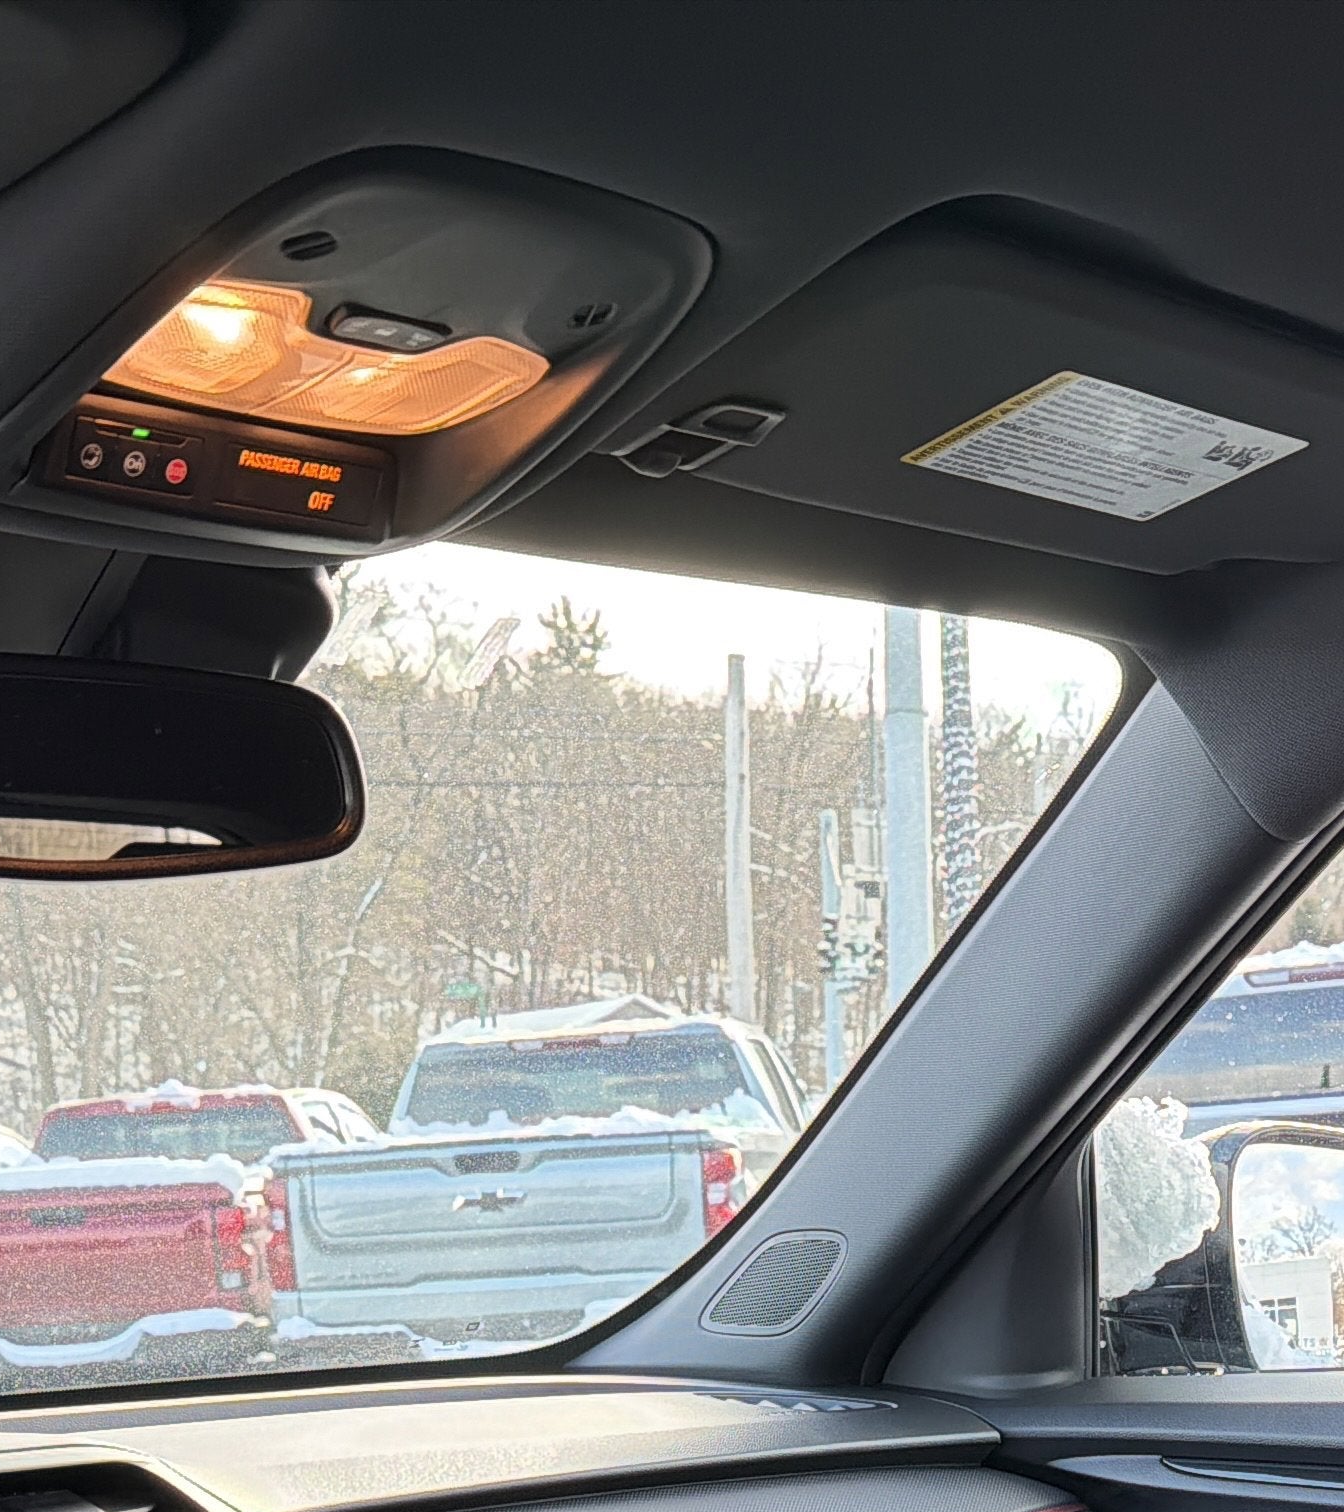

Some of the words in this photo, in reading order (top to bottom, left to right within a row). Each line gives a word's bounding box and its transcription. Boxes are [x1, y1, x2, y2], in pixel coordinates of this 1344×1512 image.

[239, 449, 301, 475] PASSENGER
[300, 461, 320, 479] AIR
[318, 464, 342, 482] BAG
[308, 491, 335, 511] OFF
